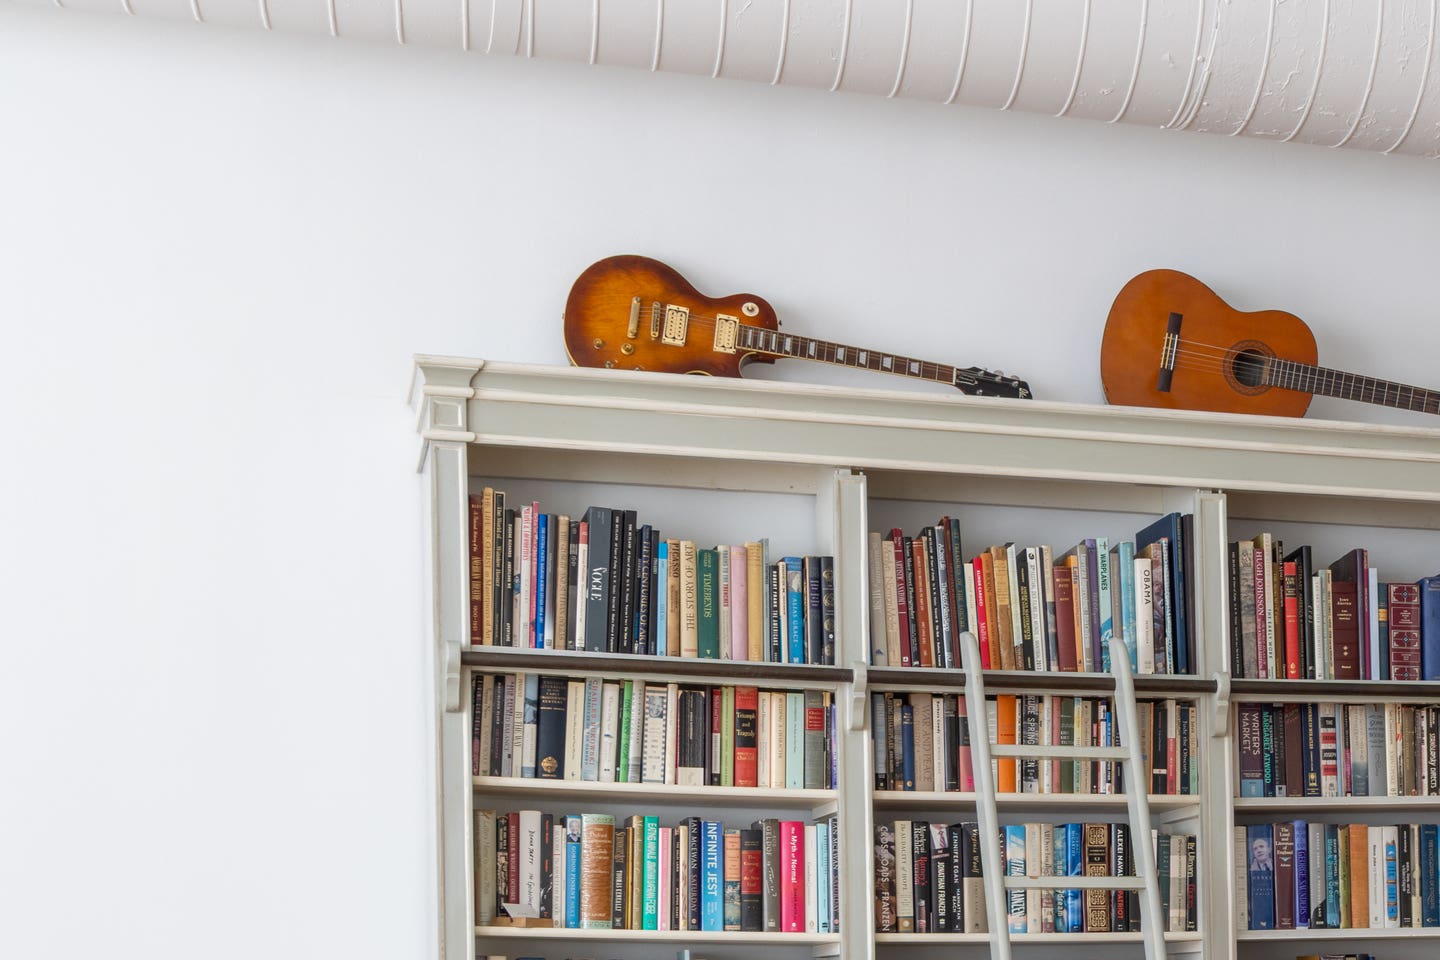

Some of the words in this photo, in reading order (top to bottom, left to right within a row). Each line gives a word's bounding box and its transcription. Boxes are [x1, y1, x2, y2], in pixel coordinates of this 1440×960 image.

[485, 530, 491, 539] OF
[686, 545, 694, 562] ART
[1254, 551, 1263, 573] HUGH
[686, 565, 694, 578] OF
[1100, 553, 1109, 591] WARPLANES
[591, 567, 607, 601] VOGUE
[686, 582, 694, 609] STORY
[704, 573, 712, 618] TIMEBENDS
[1143, 570, 1151, 604] OBAMA
[1256, 575, 1265, 616] JOHNSON
[640, 614, 648, 626] OF
[686, 614, 694, 631] THE
[639, 629, 647, 646] ART
[515, 711, 523, 719] BY
[921, 705, 930, 725] WAR
[514, 734, 522, 747] WAY
[588, 722, 596, 766] BUKOWSKI
[922, 728, 931, 751] AND
[1252, 712, 1260, 755] WRITER'S
[923, 753, 932, 783] PEACE
[707, 823, 718, 868] INFINITE
[790, 836, 798, 852] Myth
[971, 829, 979, 853] Virginia
[880, 826, 889, 882] CROSSROADS
[972, 856, 980, 873] Woolf
[707, 871, 718, 896] JEST
[881, 892, 890, 931] FRANZEN
